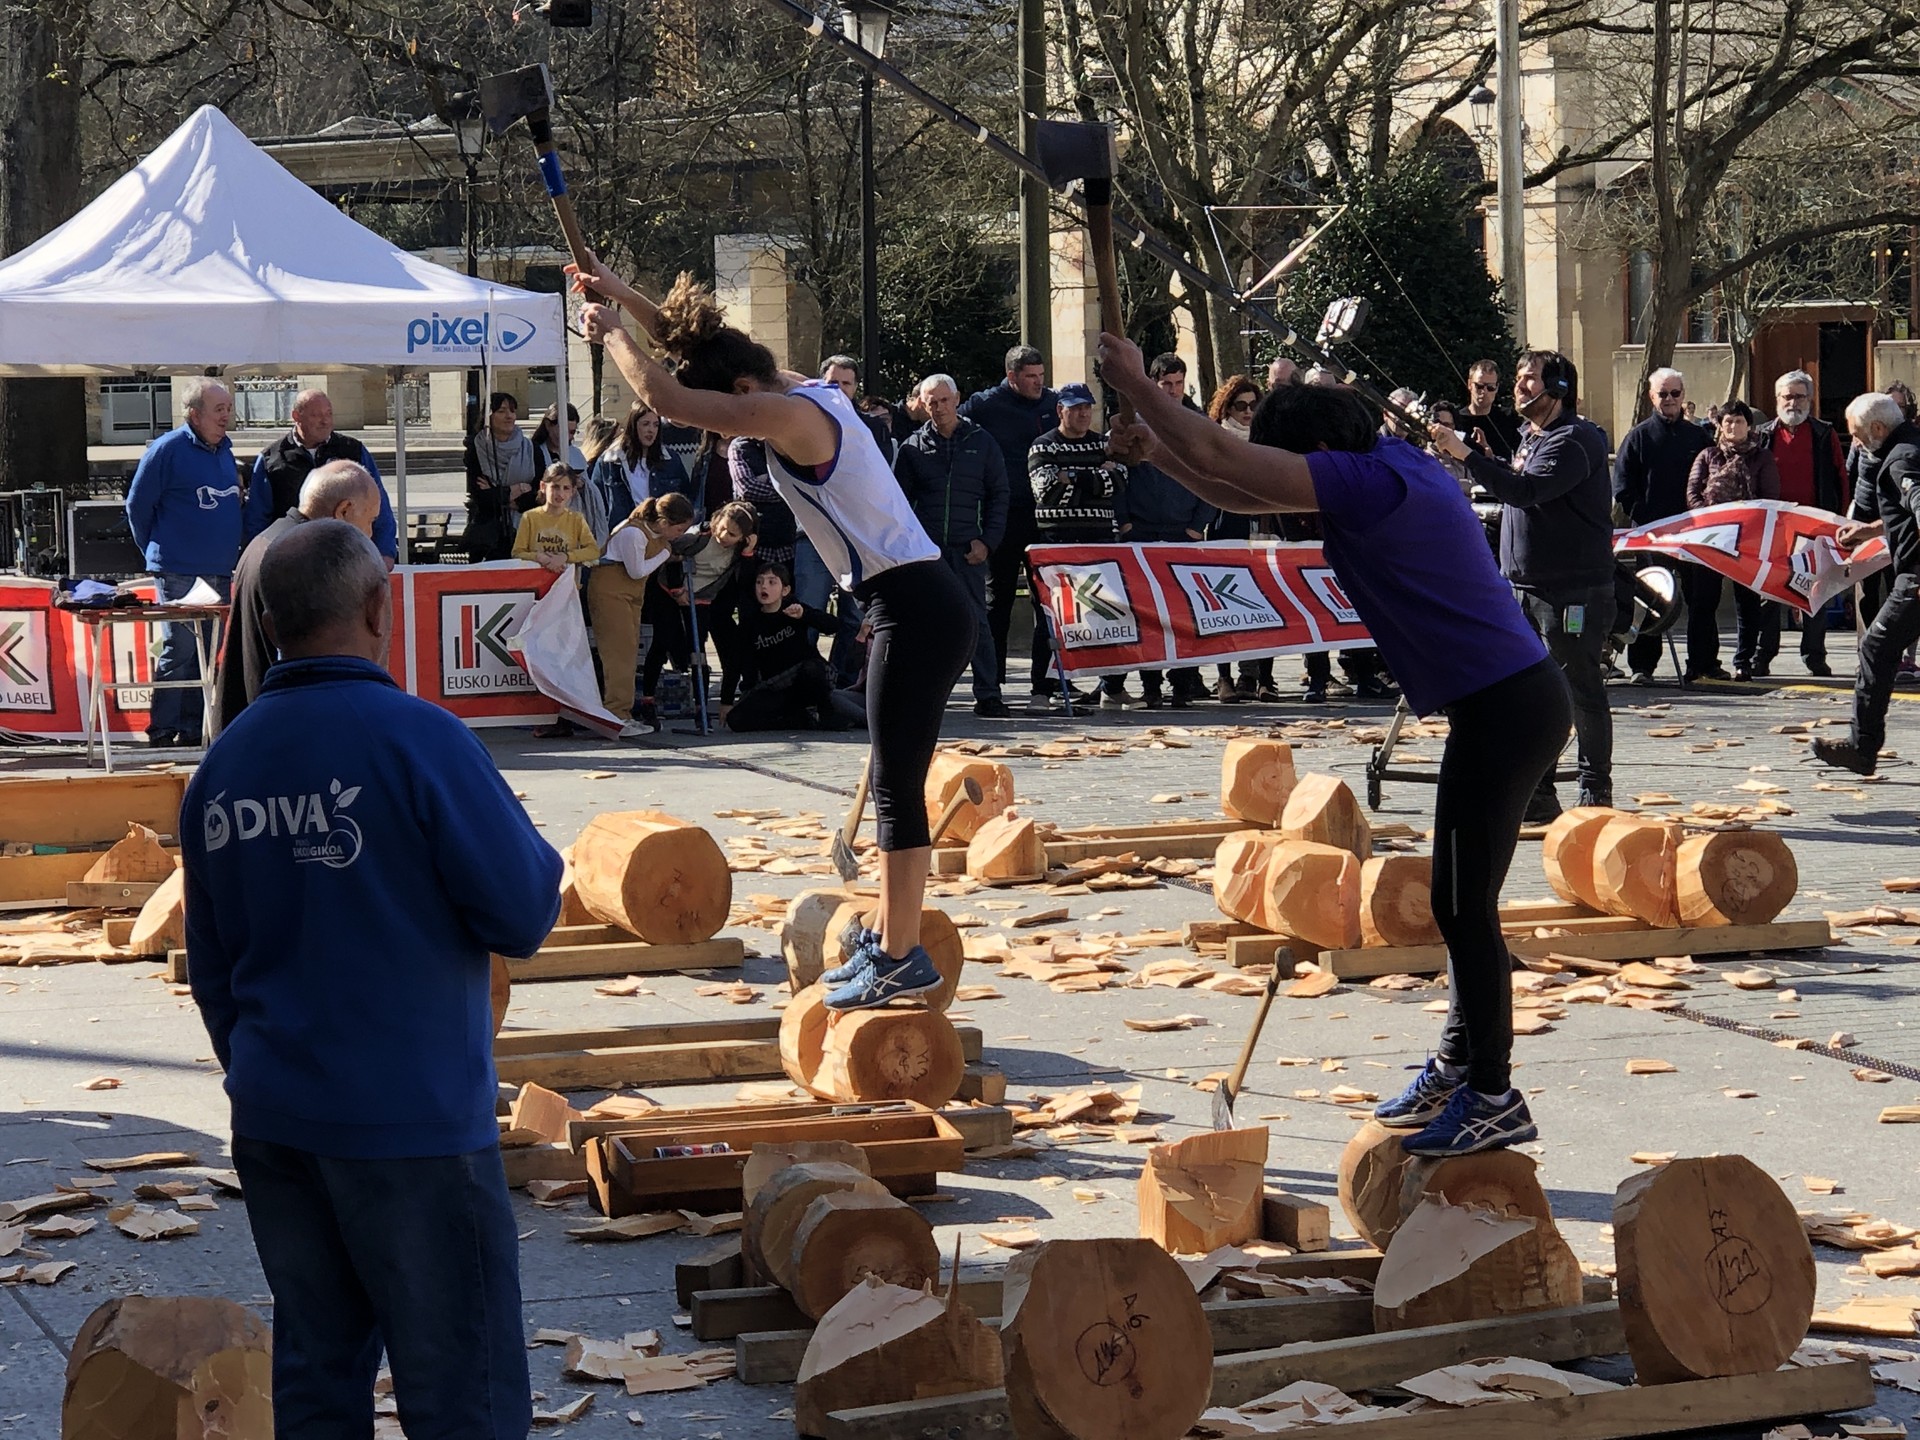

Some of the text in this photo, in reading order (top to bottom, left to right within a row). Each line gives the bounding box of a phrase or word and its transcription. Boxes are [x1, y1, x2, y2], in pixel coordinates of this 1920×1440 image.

[407, 312, 488, 353] pixel
[1200, 611, 1280, 630] EUSKO LABEL
[1337, 610, 1359, 620] EUS
[754, 625, 796, 650] Amore
[1096, 625, 1135, 640] LABEL
[447, 672, 535, 690] EUSKO LABEL
[6, 691, 49, 706] LABEL
[121, 689, 154, 704] EUS
